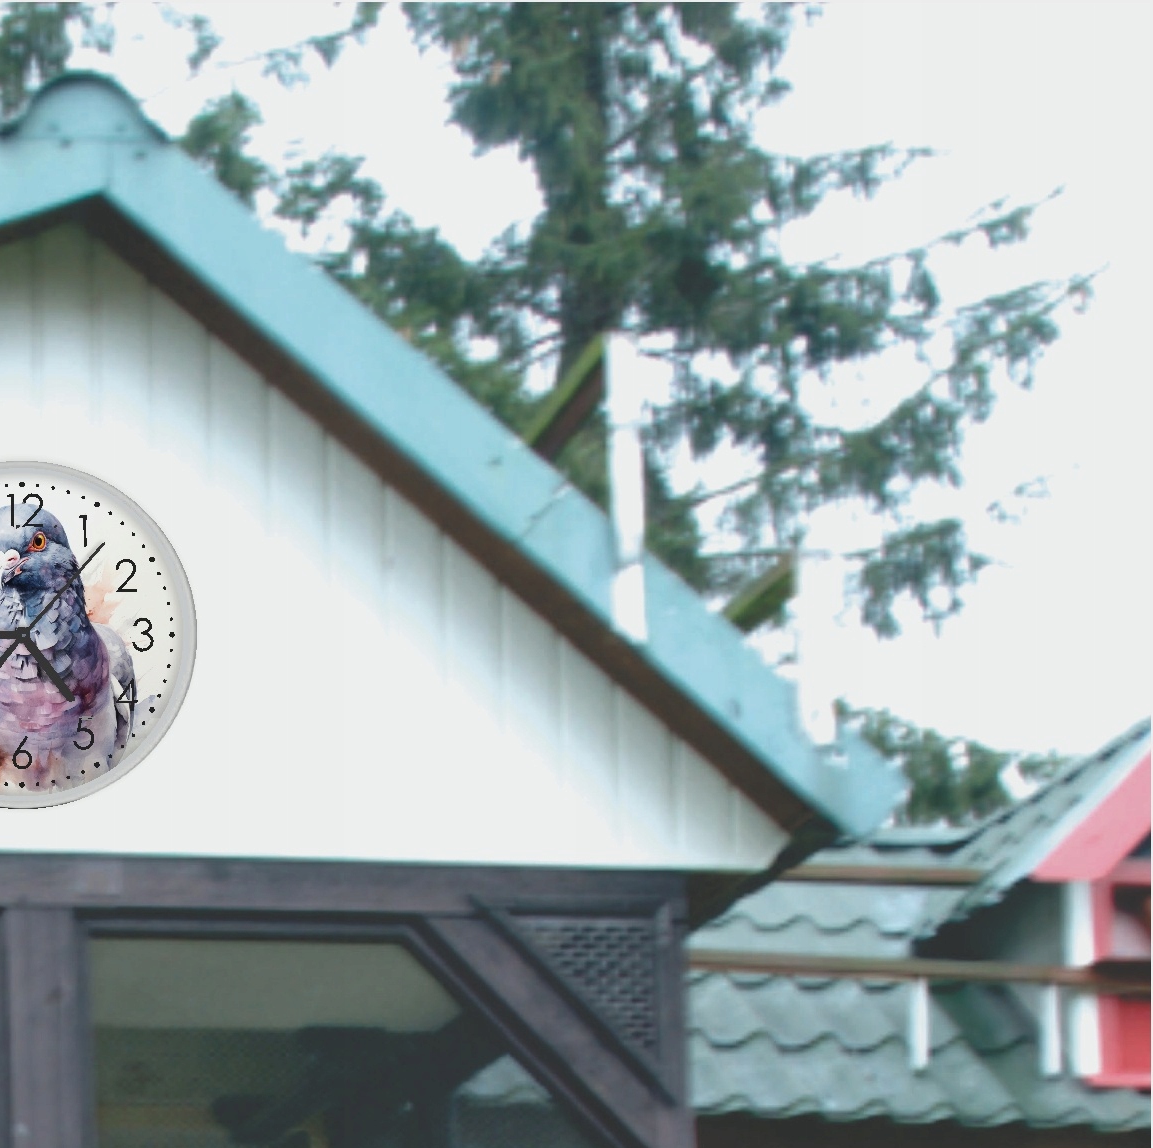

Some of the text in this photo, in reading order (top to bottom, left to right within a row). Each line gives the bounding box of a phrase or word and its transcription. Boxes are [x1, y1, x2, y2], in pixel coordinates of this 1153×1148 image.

[6, 493, 44, 528] 12
[78, 514, 89, 548] 1
[115, 558, 138, 593] 2
[132, 617, 155, 652] 3
[115, 678, 139, 712] 4
[72, 715, 95, 751] 5
[11, 735, 33, 770] 6
